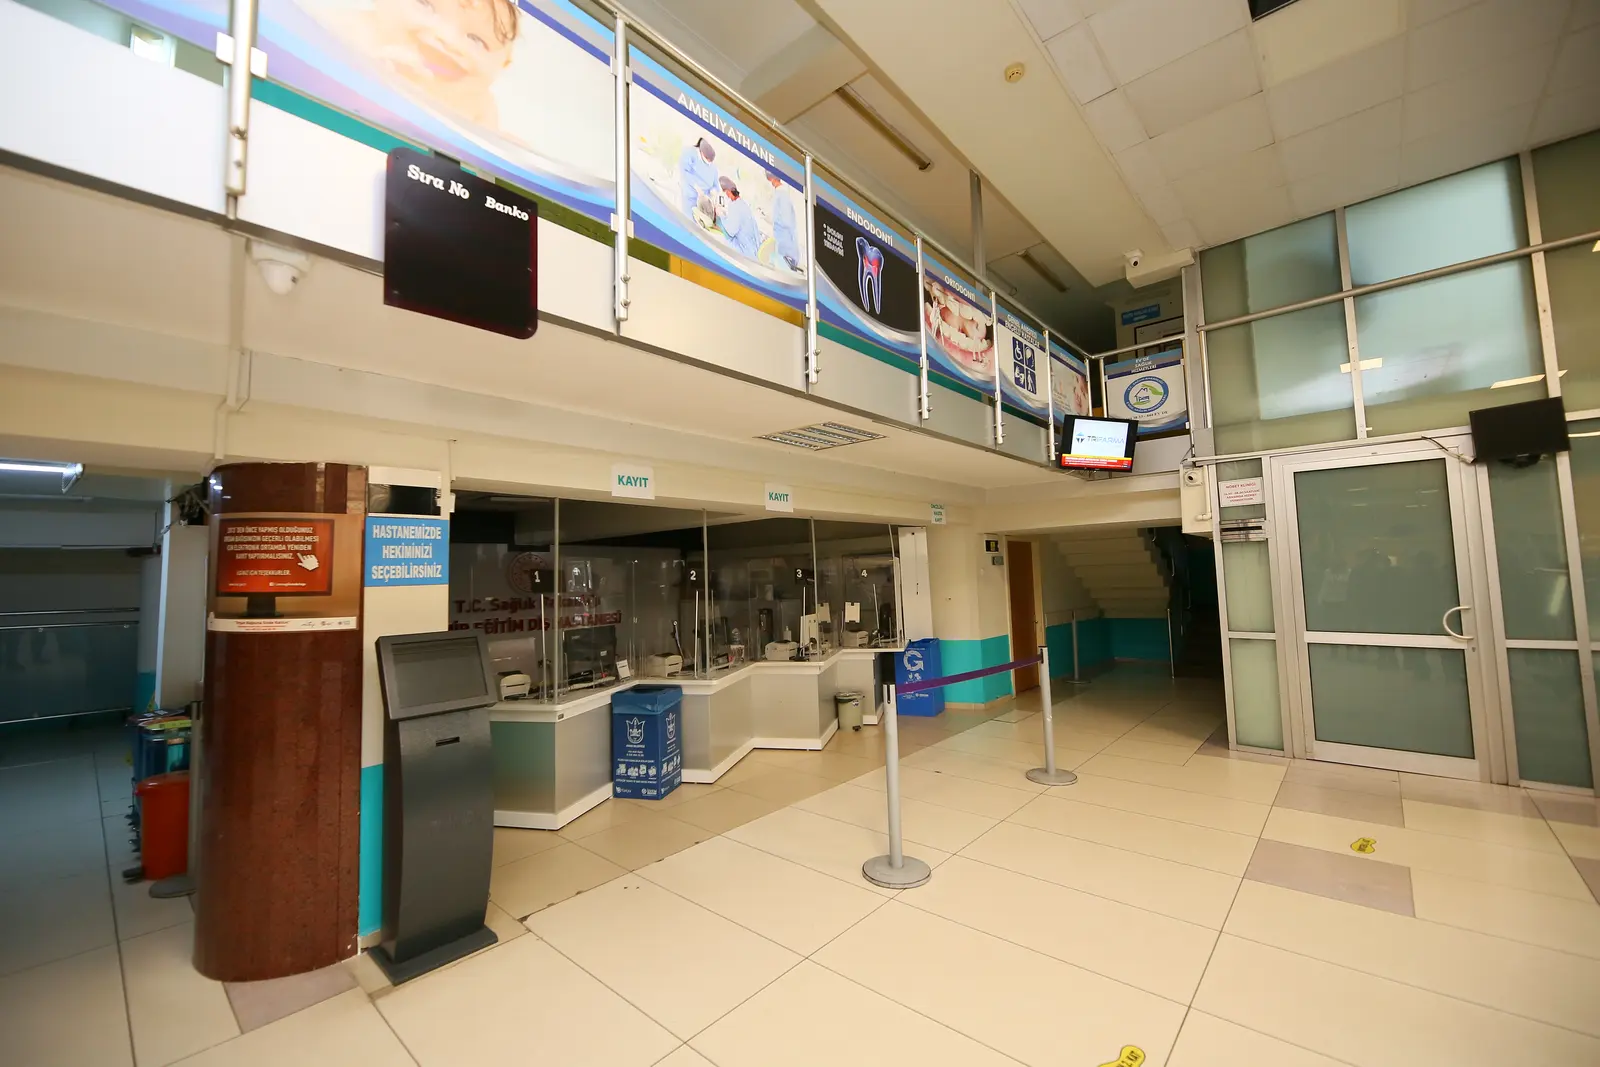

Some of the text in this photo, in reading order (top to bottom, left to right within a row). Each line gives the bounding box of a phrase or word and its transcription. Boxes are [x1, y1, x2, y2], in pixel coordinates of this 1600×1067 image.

[677, 92, 775, 167] AMELİYATHANE
[407, 164, 529, 221] Sıra No Banko
[846, 207, 893, 246] ENDODONTİ
[944, 275, 976, 302] ORTODONTİ
[617, 475, 648, 488] KAYIT
[768, 492, 789, 502] KAYIT
[372, 524, 441, 539] HASTANEMİZDE
[382, 542, 432, 558] HEKİMİNİZİ
[371, 562, 442, 582] SEÇEBİLİRSİNİZ
[534, 571, 540, 583] 1
[690, 570, 696, 581] 2
[796, 569, 802, 578] 3
[861, 569, 867, 578] 4
[552, 609, 622, 629] HATANESİ
